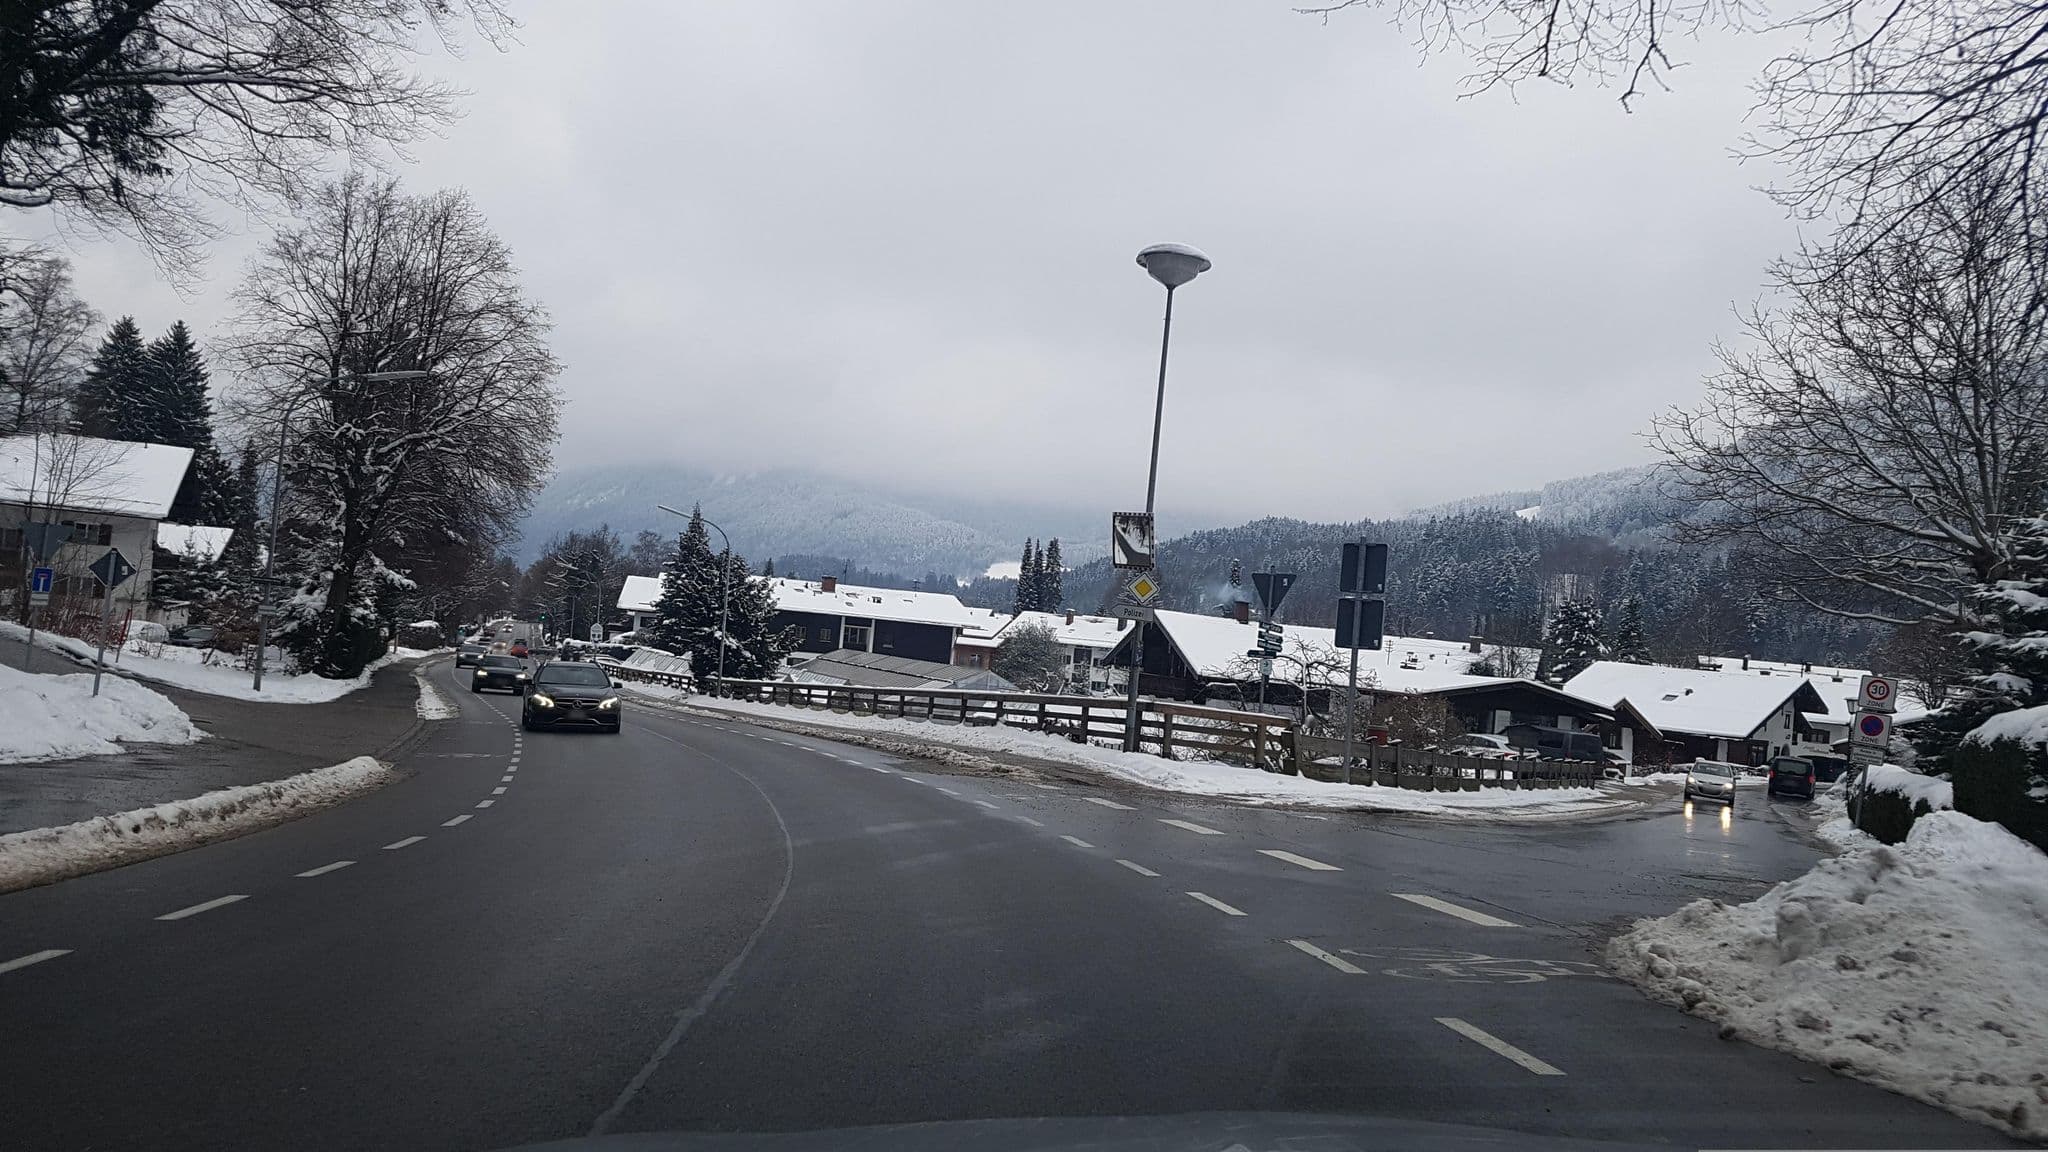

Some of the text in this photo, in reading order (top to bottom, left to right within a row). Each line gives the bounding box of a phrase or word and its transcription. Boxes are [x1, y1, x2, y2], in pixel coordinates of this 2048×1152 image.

[1123, 607, 1145, 618] Polizei
[1871, 685, 1886, 696] 30
[1866, 700, 1885, 708] ZONE
[1860, 736, 1880, 744] ZONE
